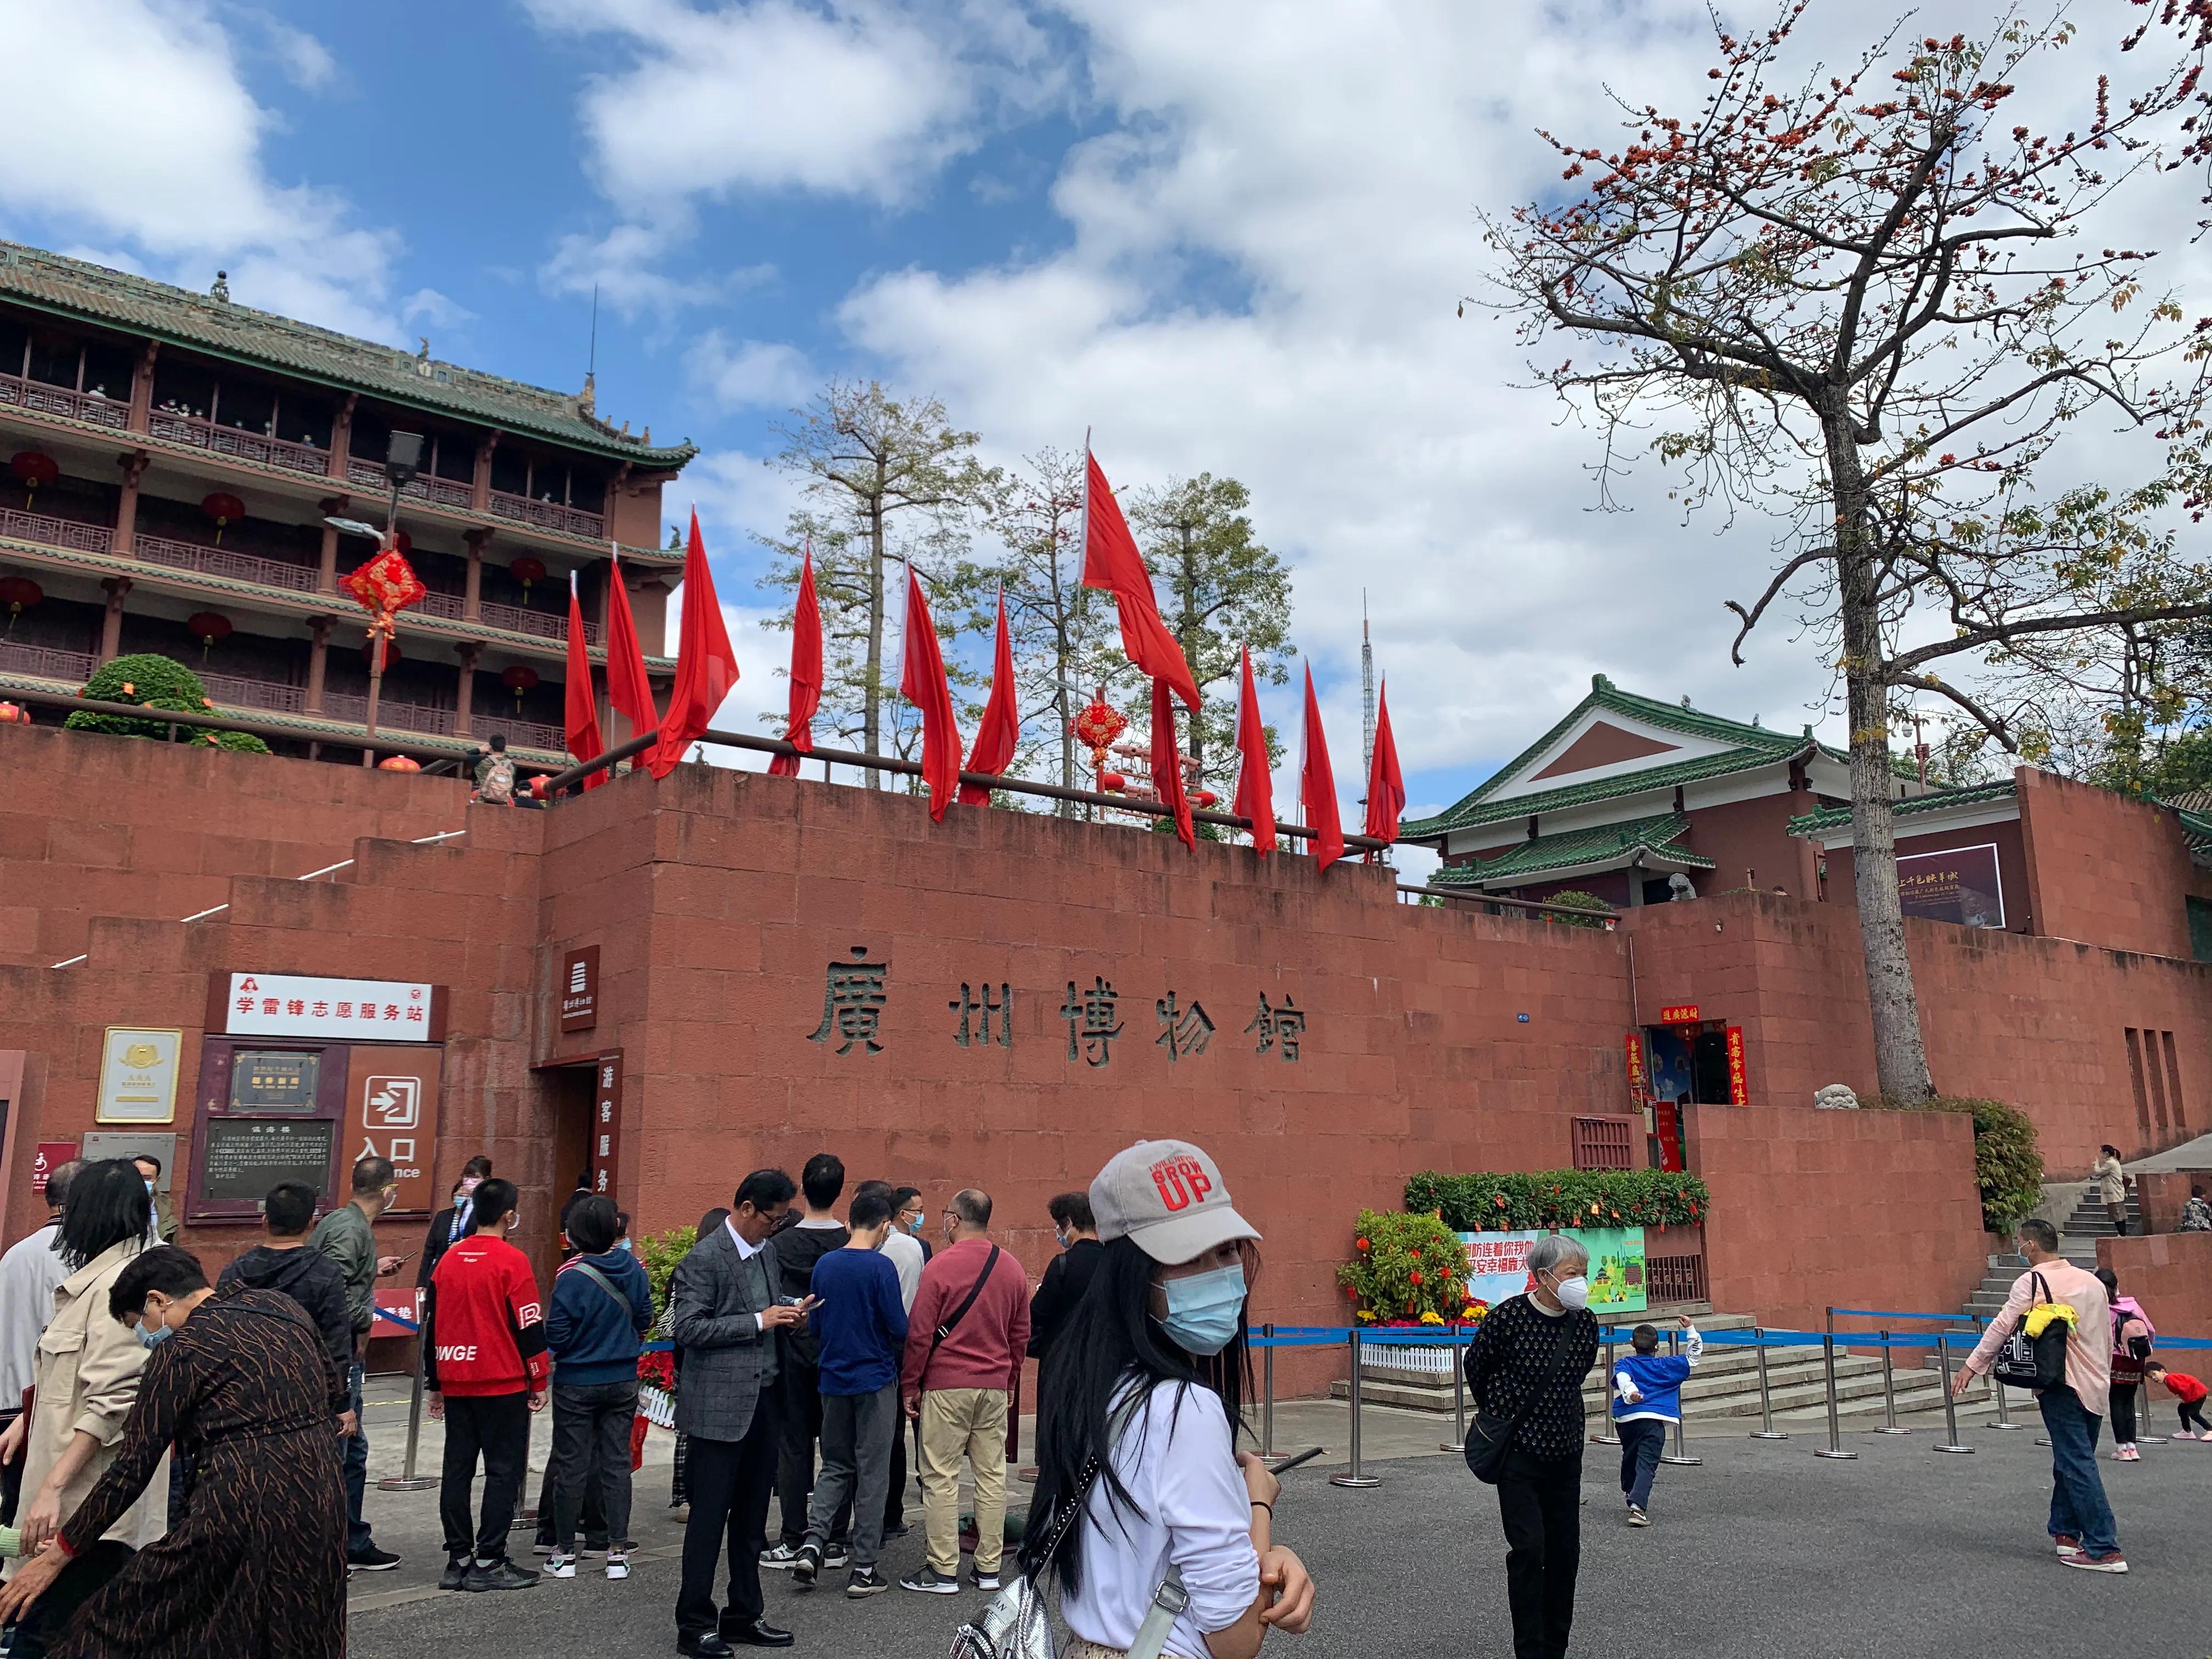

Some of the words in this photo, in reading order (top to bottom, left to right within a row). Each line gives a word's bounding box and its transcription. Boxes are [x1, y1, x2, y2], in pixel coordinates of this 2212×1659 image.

[236, 996, 424, 1022] 学雷锋志愿服务站
[805, 946, 1306, 1068] 廣州博物館
[597, 1065, 614, 1192] 游客服务
[354, 1136, 415, 1162] 入口
[1152, 1161, 1203, 1184] GROW
[1158, 1173, 1211, 1211] UP
